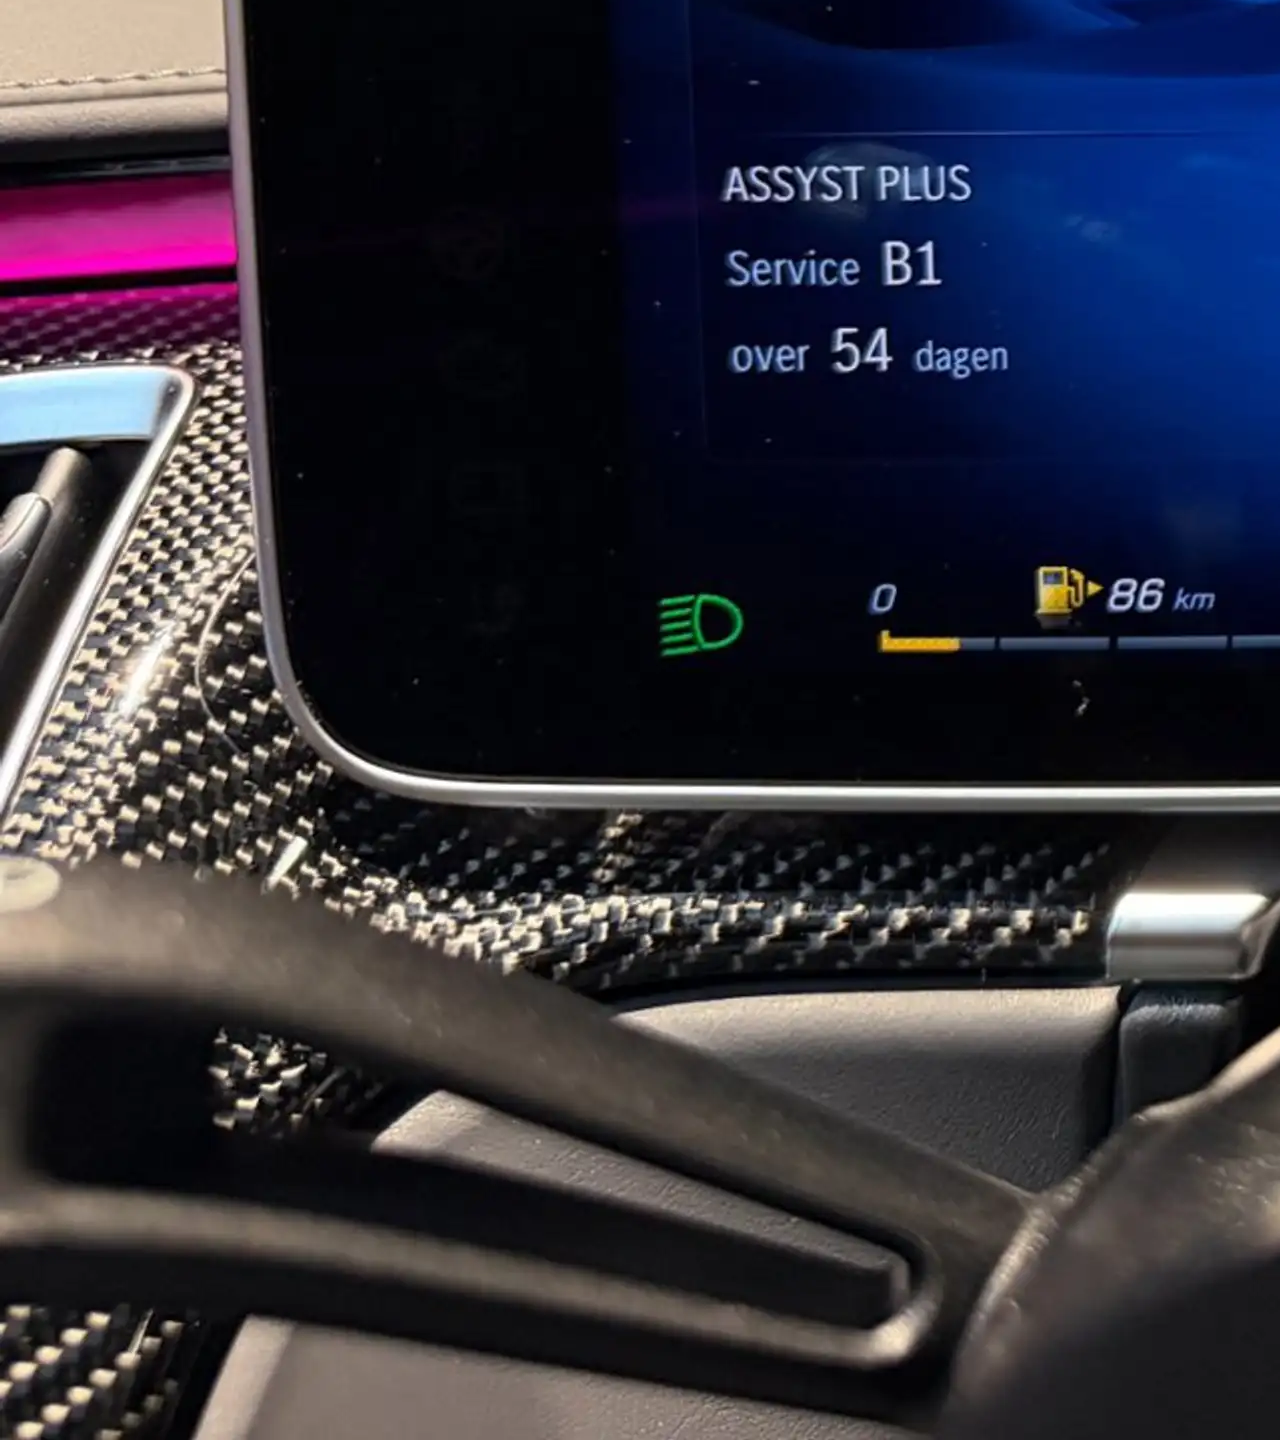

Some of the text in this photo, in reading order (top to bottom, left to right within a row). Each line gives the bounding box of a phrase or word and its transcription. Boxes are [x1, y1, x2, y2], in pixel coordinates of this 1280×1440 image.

[721, 165, 972, 202] ASSYST PLUS
[726, 241, 942, 287] Service B1
[730, 327, 1008, 379] over 54 dagen
[870, 583, 897, 613] 0
[1107, 578, 1215, 612] 86 km
